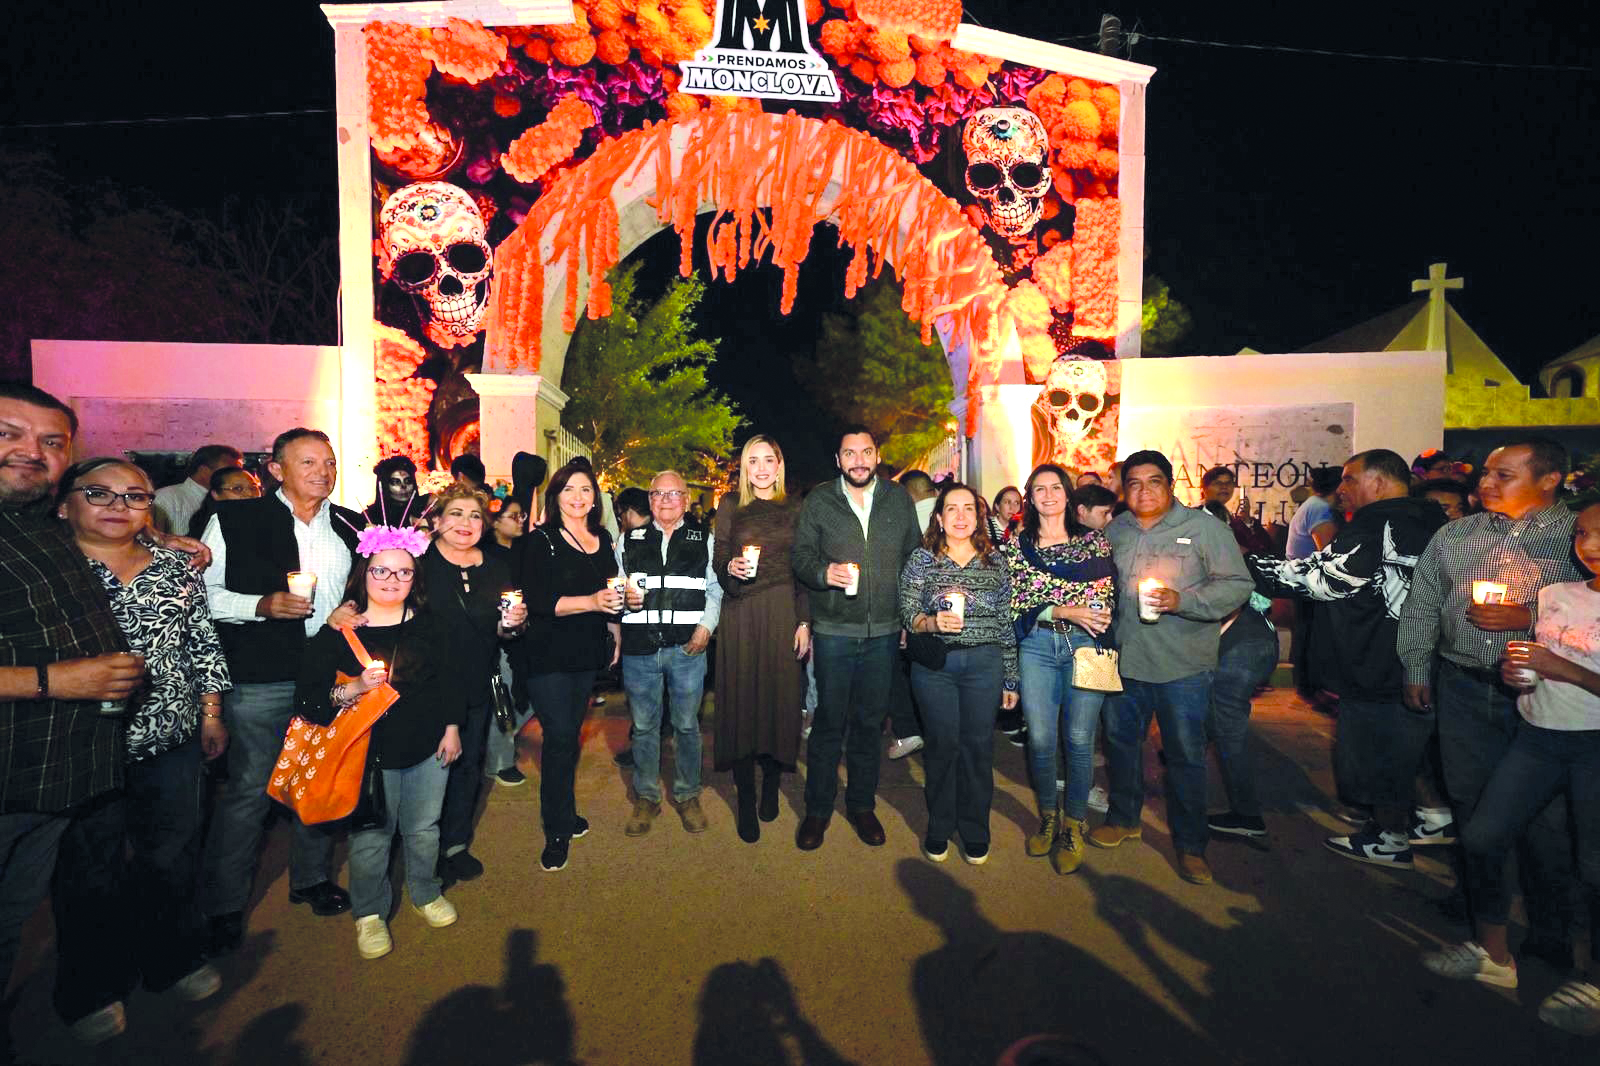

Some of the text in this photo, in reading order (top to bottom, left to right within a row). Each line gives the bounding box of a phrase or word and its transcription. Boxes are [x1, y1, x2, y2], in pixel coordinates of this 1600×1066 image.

[717, 54, 807, 70] PRENDAMOS
[686, 66, 835, 97] MONCLOVA
[1173, 457, 1329, 489] ANTEÓN
